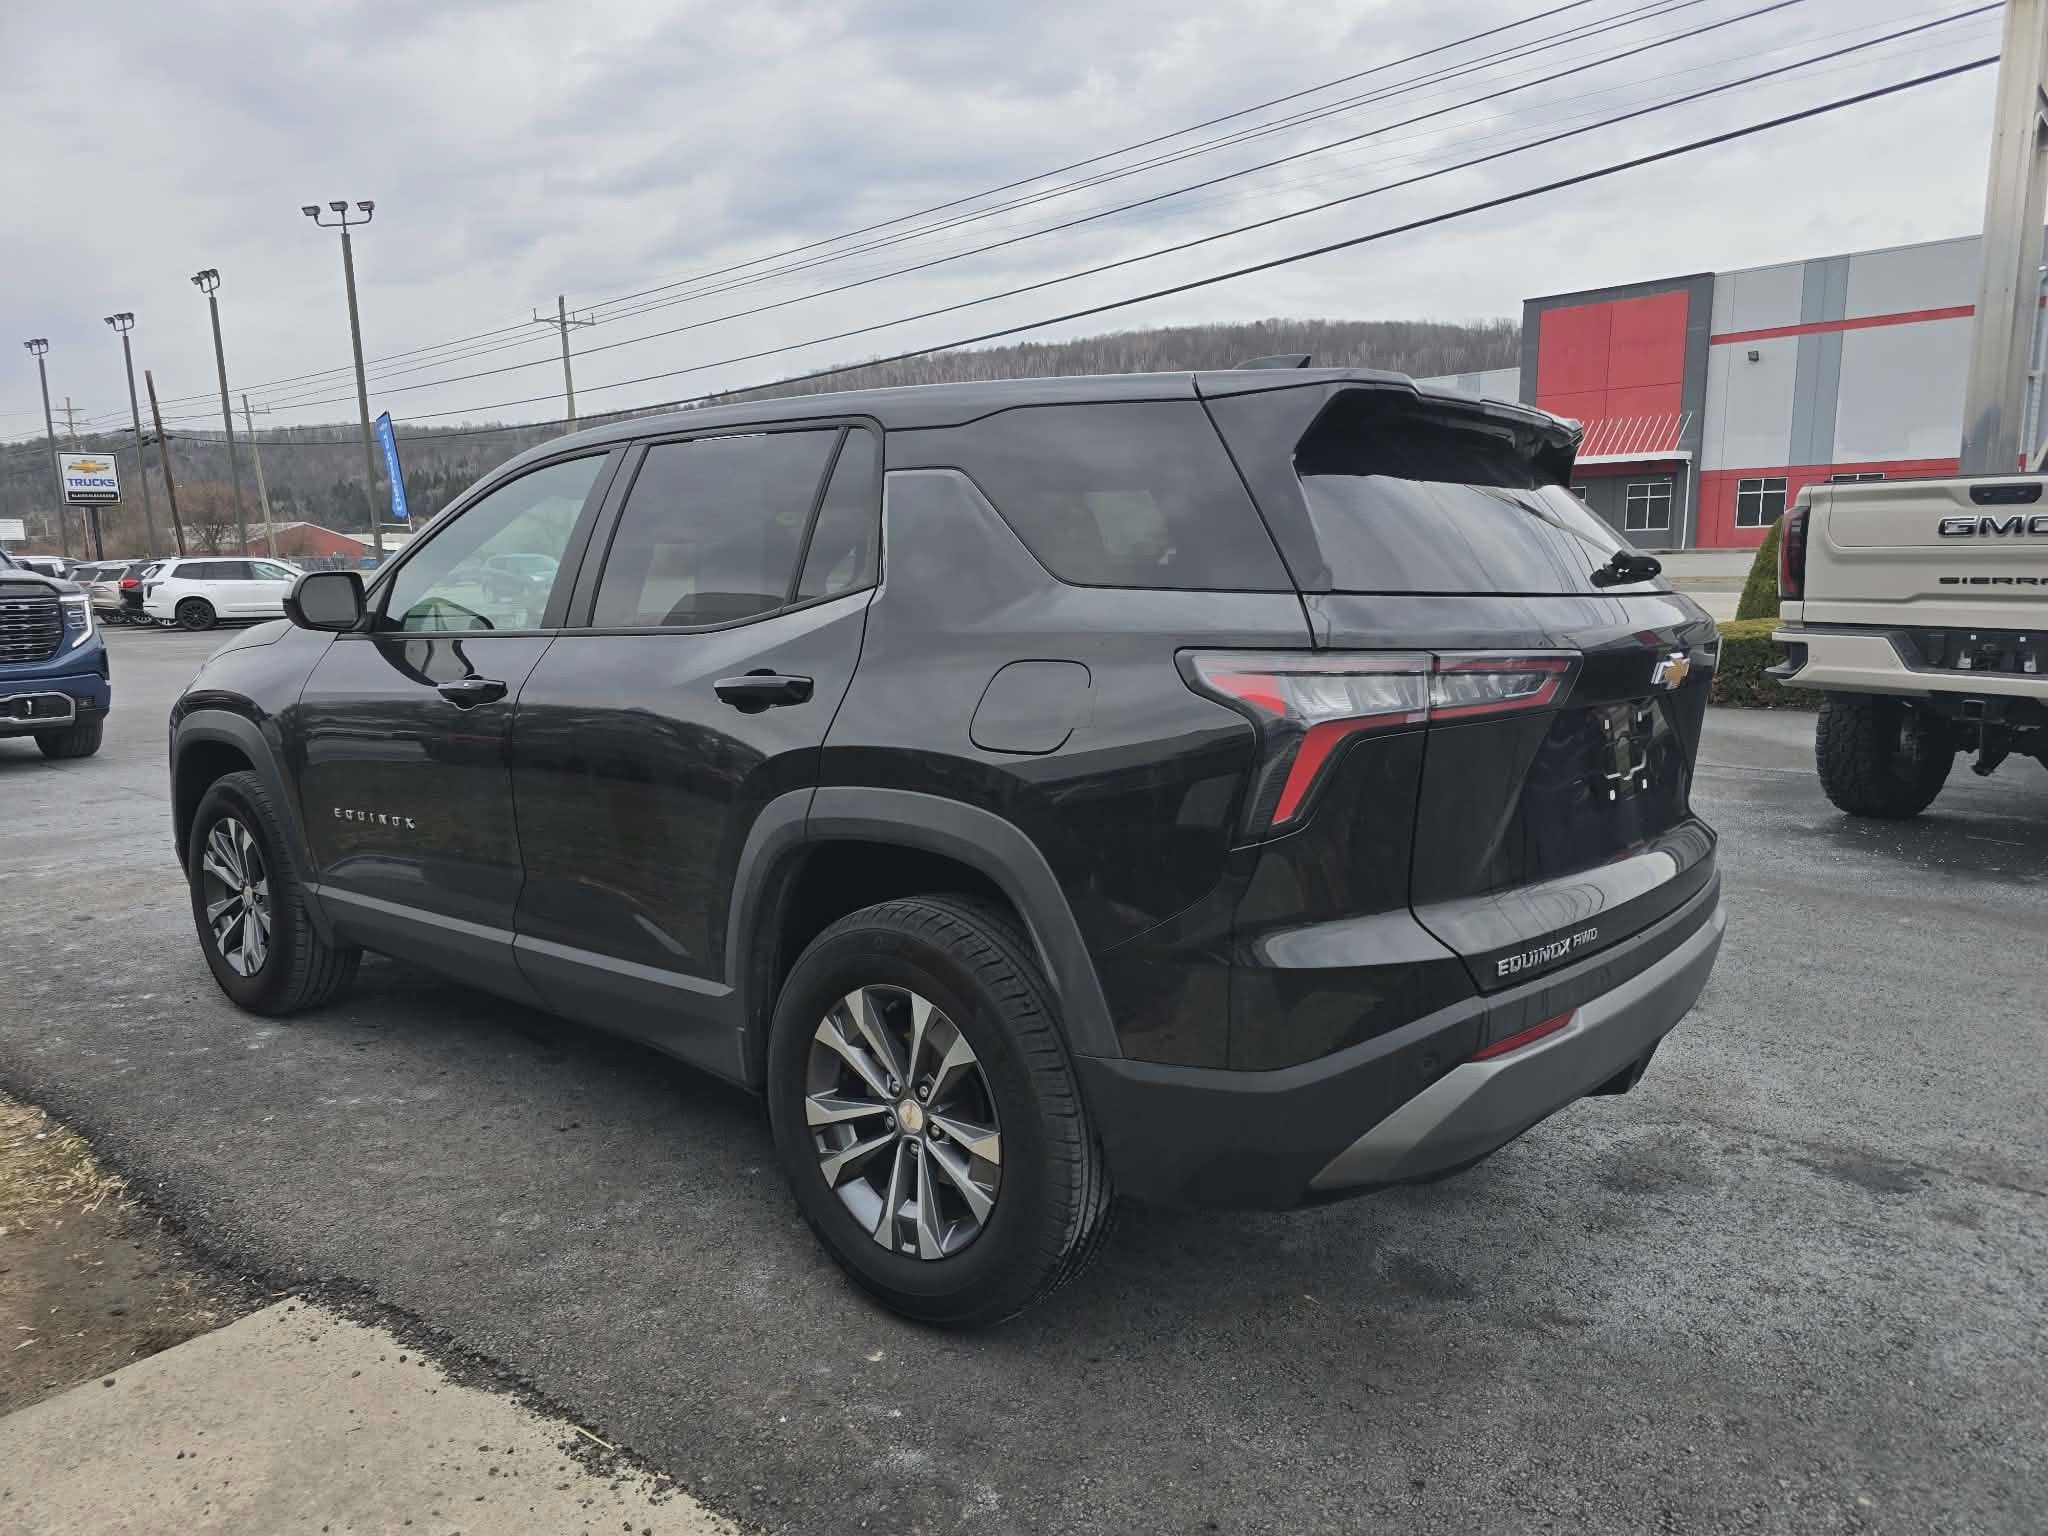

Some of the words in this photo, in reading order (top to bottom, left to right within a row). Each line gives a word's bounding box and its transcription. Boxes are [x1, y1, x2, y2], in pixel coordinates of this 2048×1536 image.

[66, 478, 115, 487] TRUCKS
[333, 807, 415, 829] EQUINOX
[1497, 938, 1571, 977] EQUINOX
[1573, 927, 1598, 949] AWD
